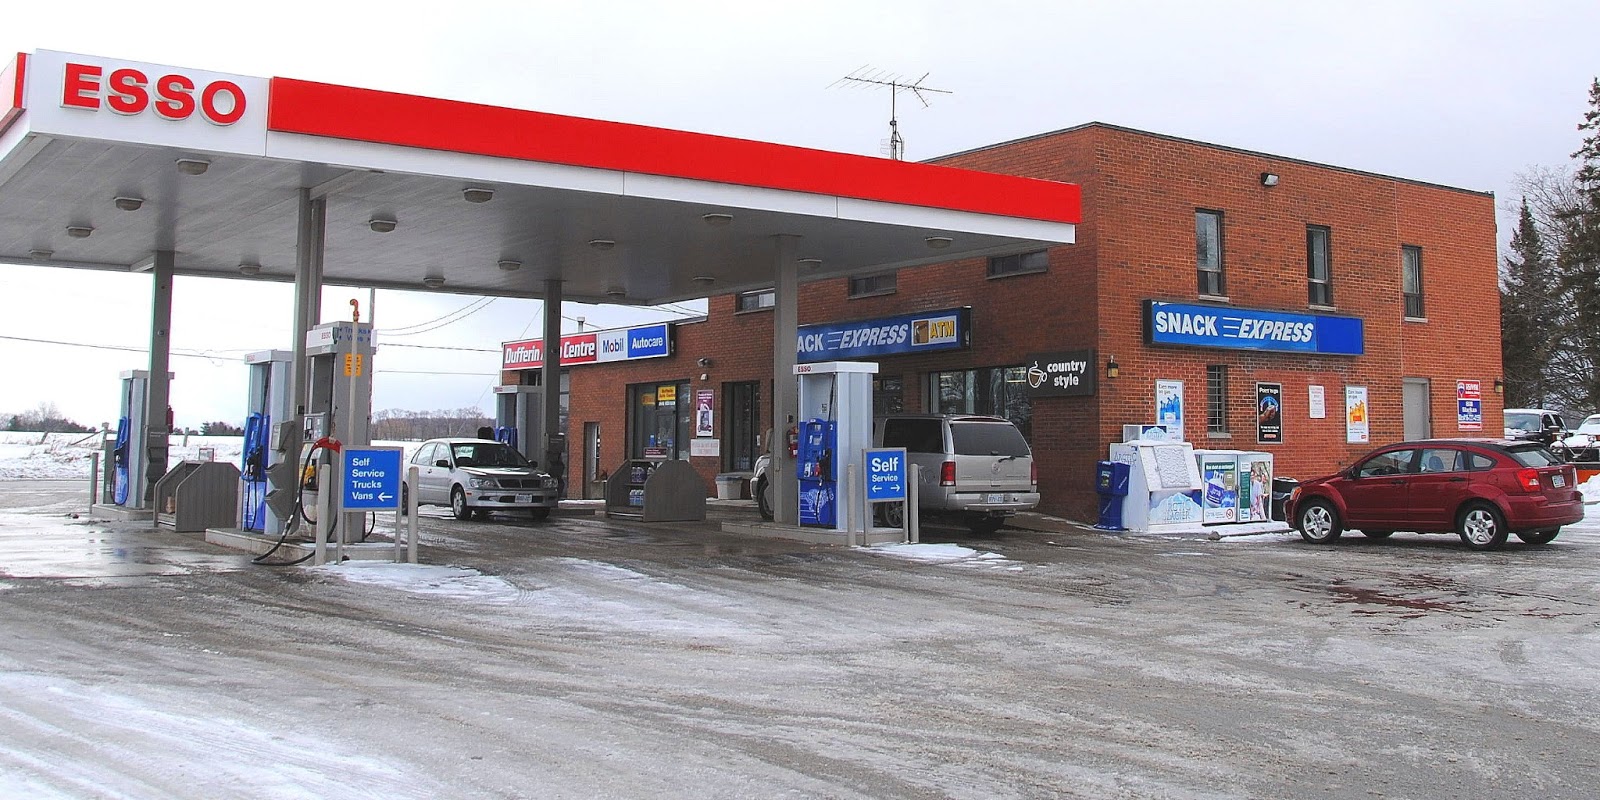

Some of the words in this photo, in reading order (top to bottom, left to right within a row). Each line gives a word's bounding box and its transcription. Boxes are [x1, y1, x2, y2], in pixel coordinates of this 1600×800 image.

[61, 62, 246, 126] ESSO
[930, 320, 955, 338] ATM
[1155, 311, 1218, 337] SNACK
[1238, 318, 1314, 343] EXPRESS
[602, 338, 624, 353] Mobil
[632, 335, 663, 350] Autocare
[797, 333, 824, 353] ACK
[839, 323, 908, 349] EXPRESS
[504, 346, 540, 364] Dufferin
[563, 340, 595, 358] Centre
[797, 365, 811, 373] ESSO
[1047, 360, 1087, 374] country
[1053, 373, 1079, 389] style
[352, 457, 371, 466] Self
[871, 456, 899, 472] Self
[352, 468, 385, 478] Service
[871, 473, 898, 482] Service
[352, 480, 382, 489] Trucks
[352, 491, 374, 500] Vans
